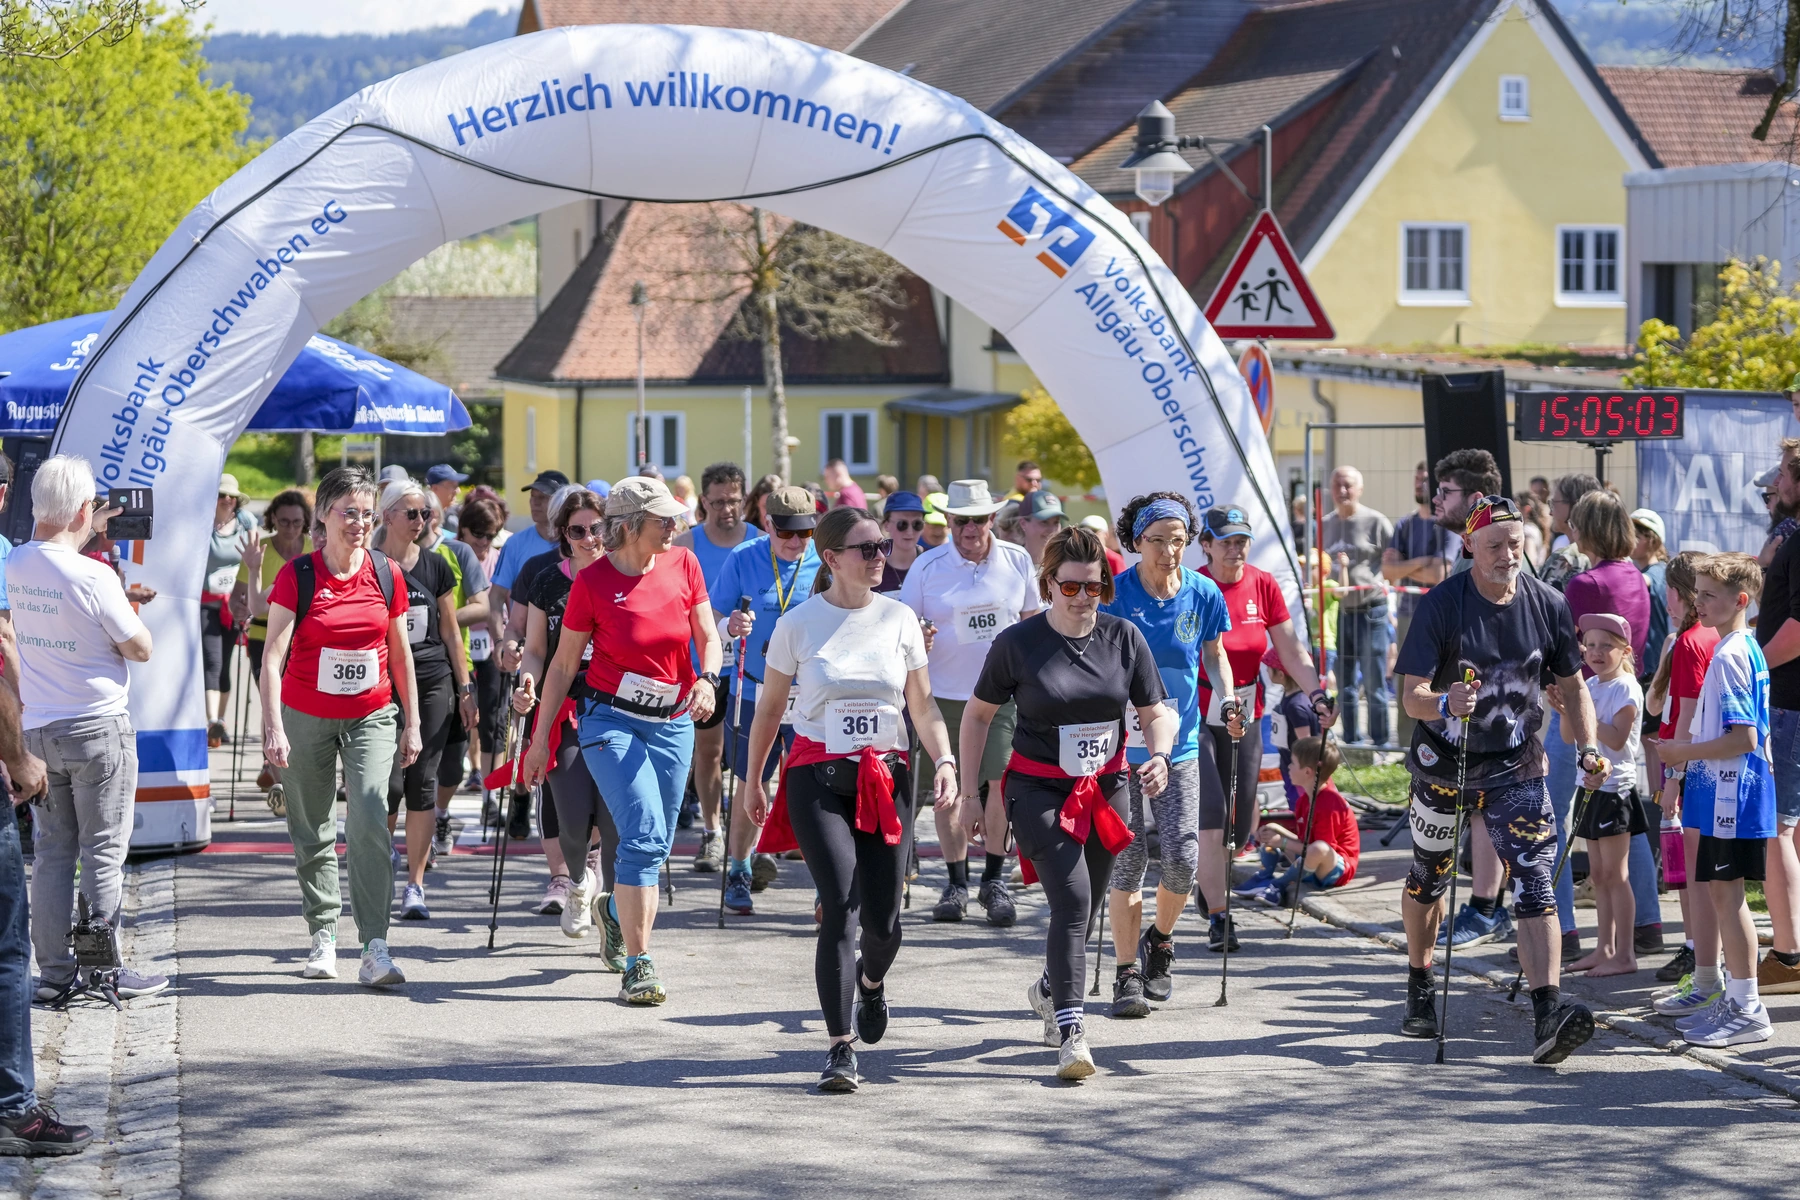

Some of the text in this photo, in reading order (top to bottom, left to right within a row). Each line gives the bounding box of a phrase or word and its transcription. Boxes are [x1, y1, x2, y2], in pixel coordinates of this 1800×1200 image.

[447, 70, 902, 155] Herzlich willkommen!
[1103, 256, 1200, 382] Volksbank
[128, 199, 349, 488] llgäu-Oberschwaben eG
[1074, 281, 1214, 522] Allgäu-Oberschwa
[6, 400, 65, 424] Augusti
[1538, 396, 1680, 436] 15:05:03
[7, 583, 64, 600] Die Nachricht
[16, 600, 59, 615] ist das Ziel
[968, 612, 997, 629] 468
[333, 663, 367, 680] 369
[631, 689, 664, 708] 371
[842, 715, 879, 736] 361
[1078, 724, 1110, 732] Leiblachlauf
[1077, 738, 1109, 759] 354
[1719, 770, 1738, 779] PARK
[1716, 816, 1735, 824] PARK
